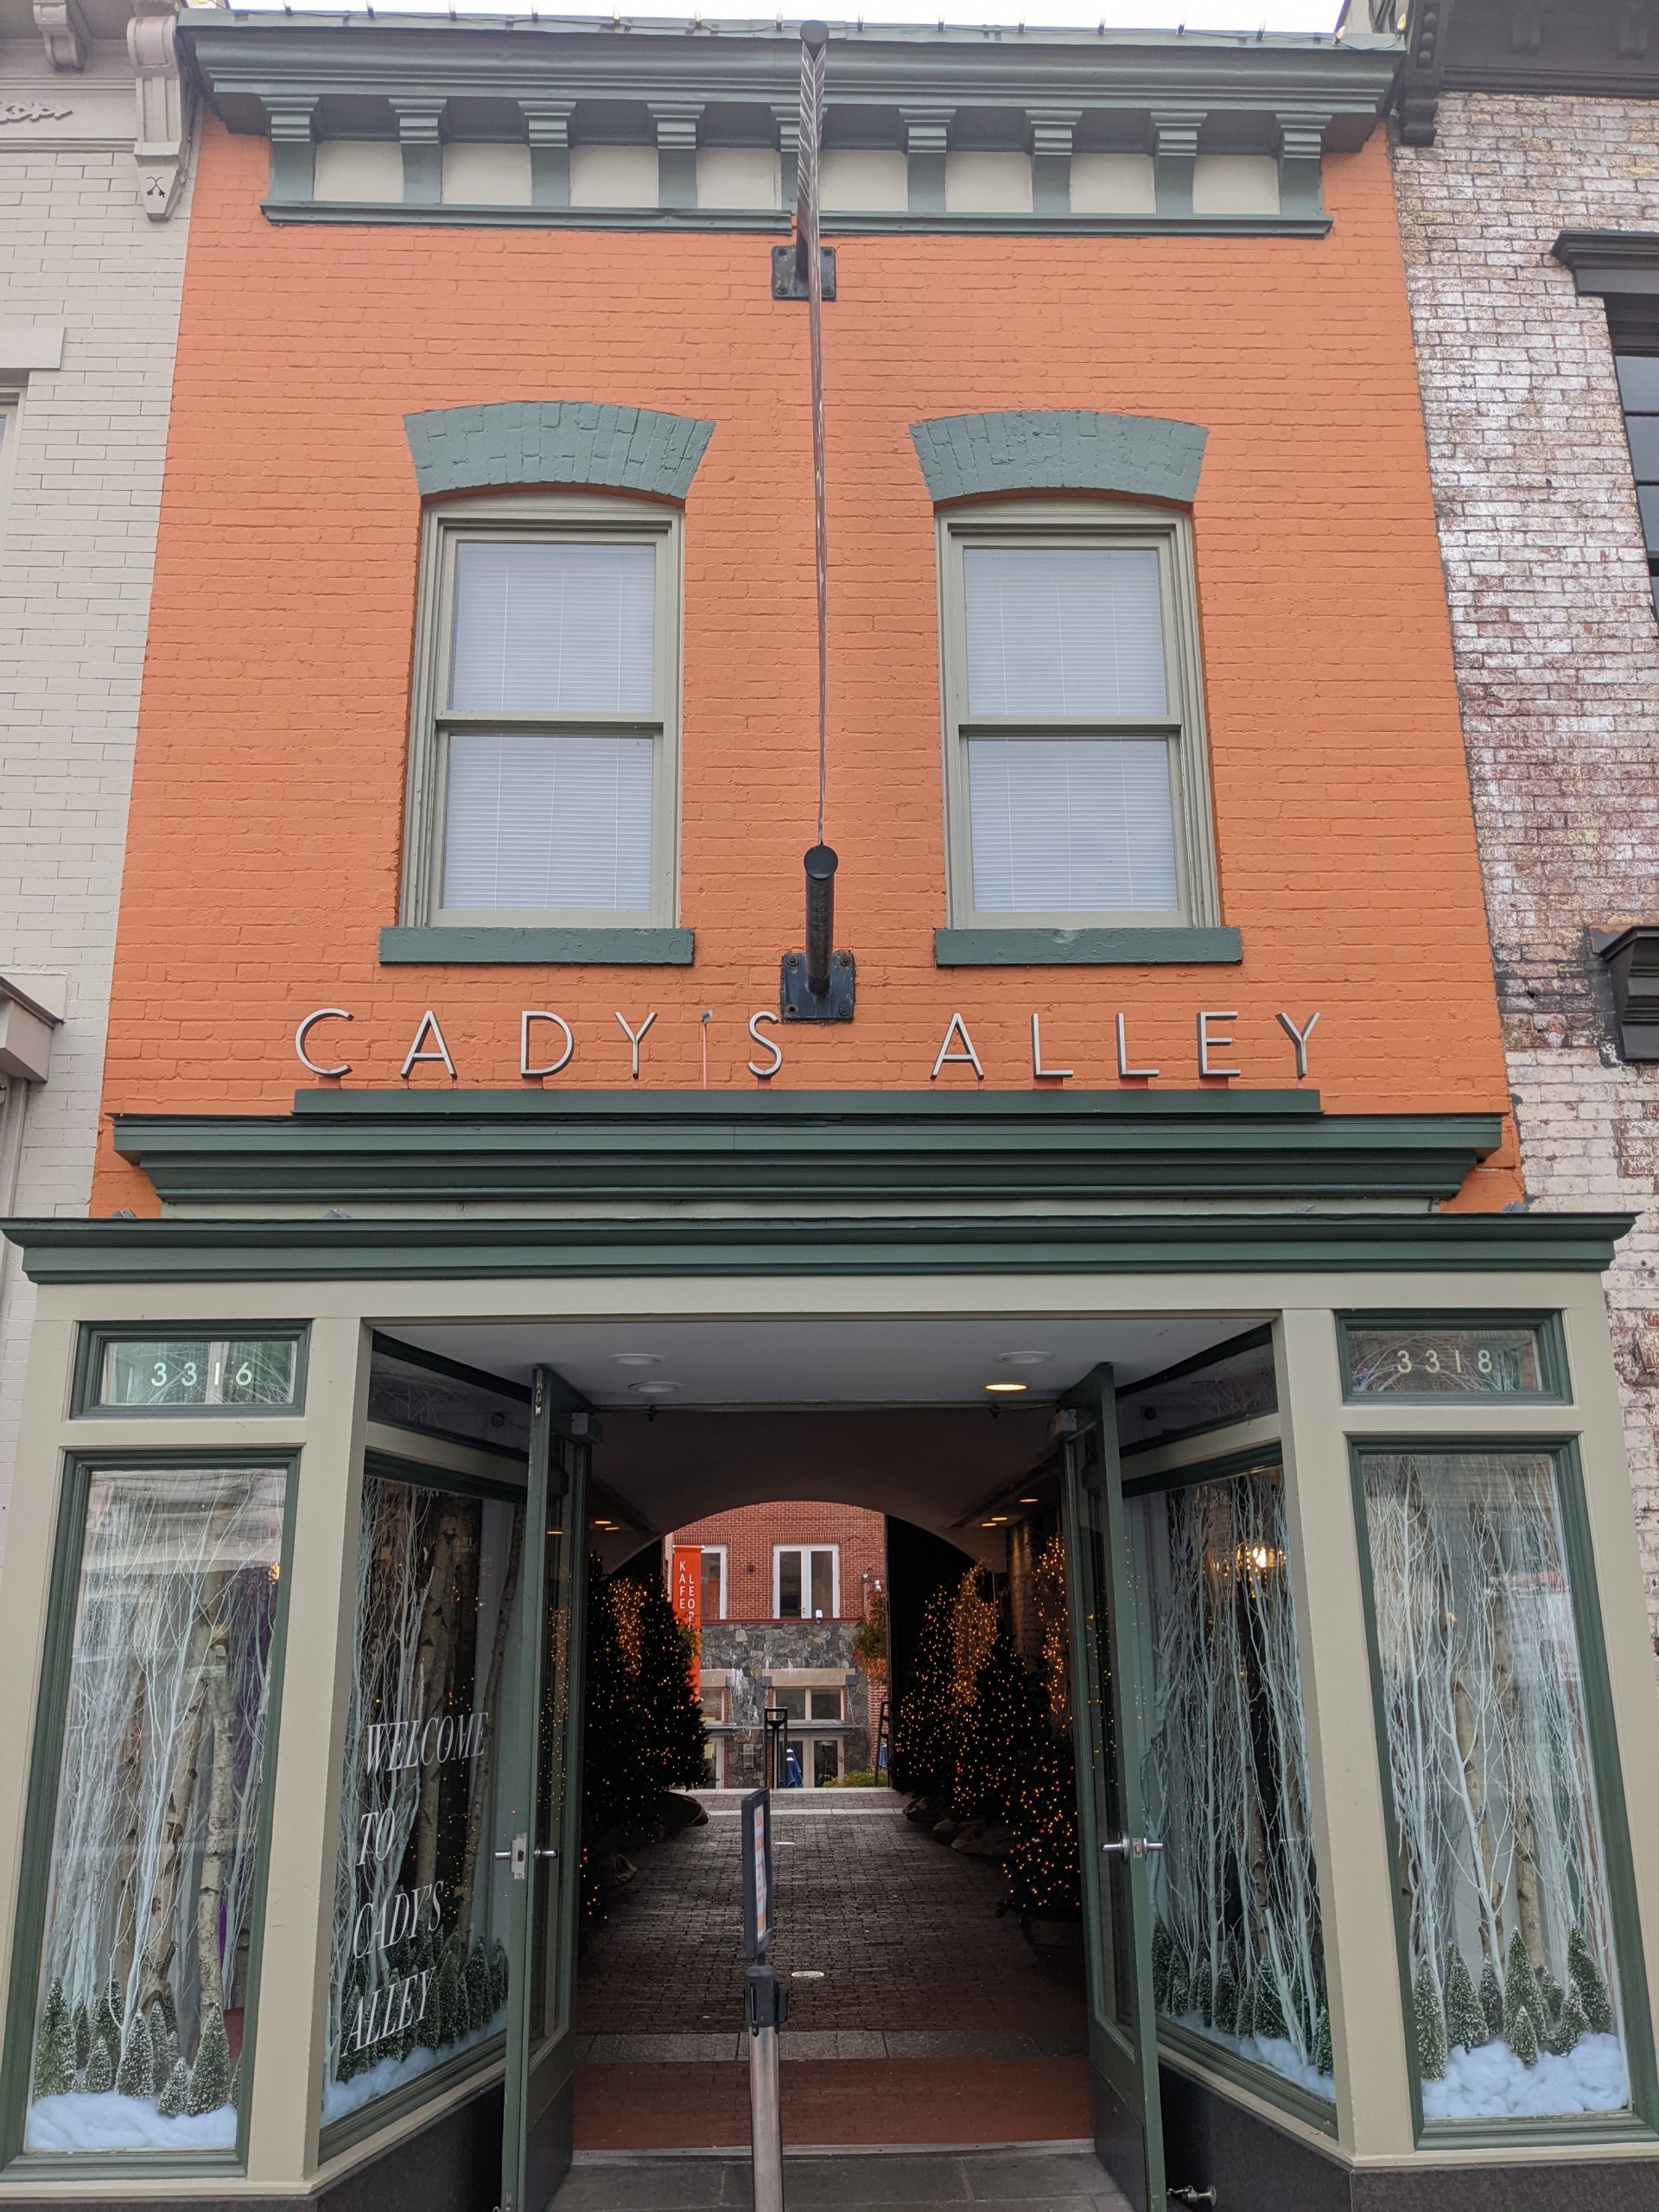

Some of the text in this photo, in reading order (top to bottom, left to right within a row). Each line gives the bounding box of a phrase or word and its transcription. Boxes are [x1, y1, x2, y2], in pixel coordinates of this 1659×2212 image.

[296, 1007, 1321, 1079] CADY'S ALLEY
[150, 1362, 252, 1386] 3316
[1396, 1350, 1493, 1374] 3318
[365, 1712, 489, 1776] WELCOME
[356, 1808, 395, 1866] TO
[353, 1880, 444, 1959] CADY'S
[340, 1966, 436, 2057] ALLEY
